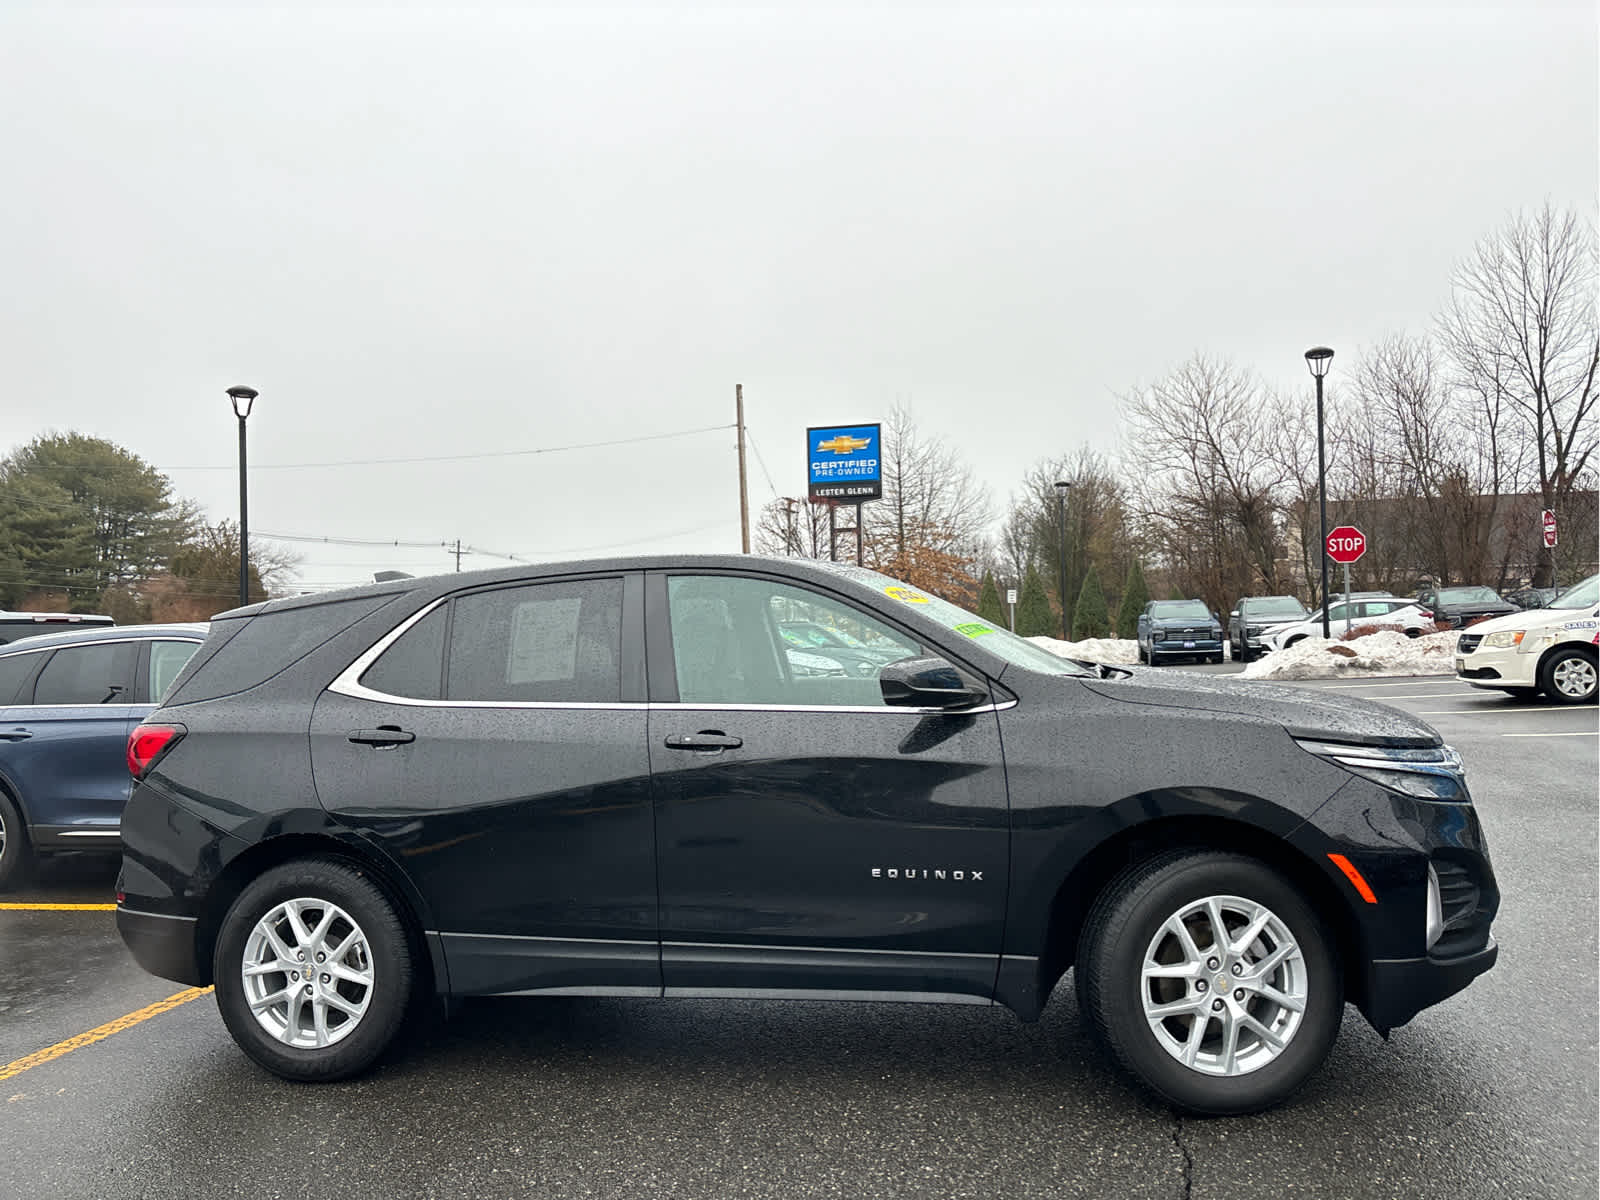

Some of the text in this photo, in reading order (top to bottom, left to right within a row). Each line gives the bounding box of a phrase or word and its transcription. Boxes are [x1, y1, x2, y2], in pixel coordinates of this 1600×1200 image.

[812, 459, 877, 470] CERTIFIED
[815, 467, 874, 477] PRE-OWNED
[816, 487, 874, 496] LESTER GLENN
[1328, 537, 1363, 552] STOP
[871, 868, 984, 881] EQUINOX
